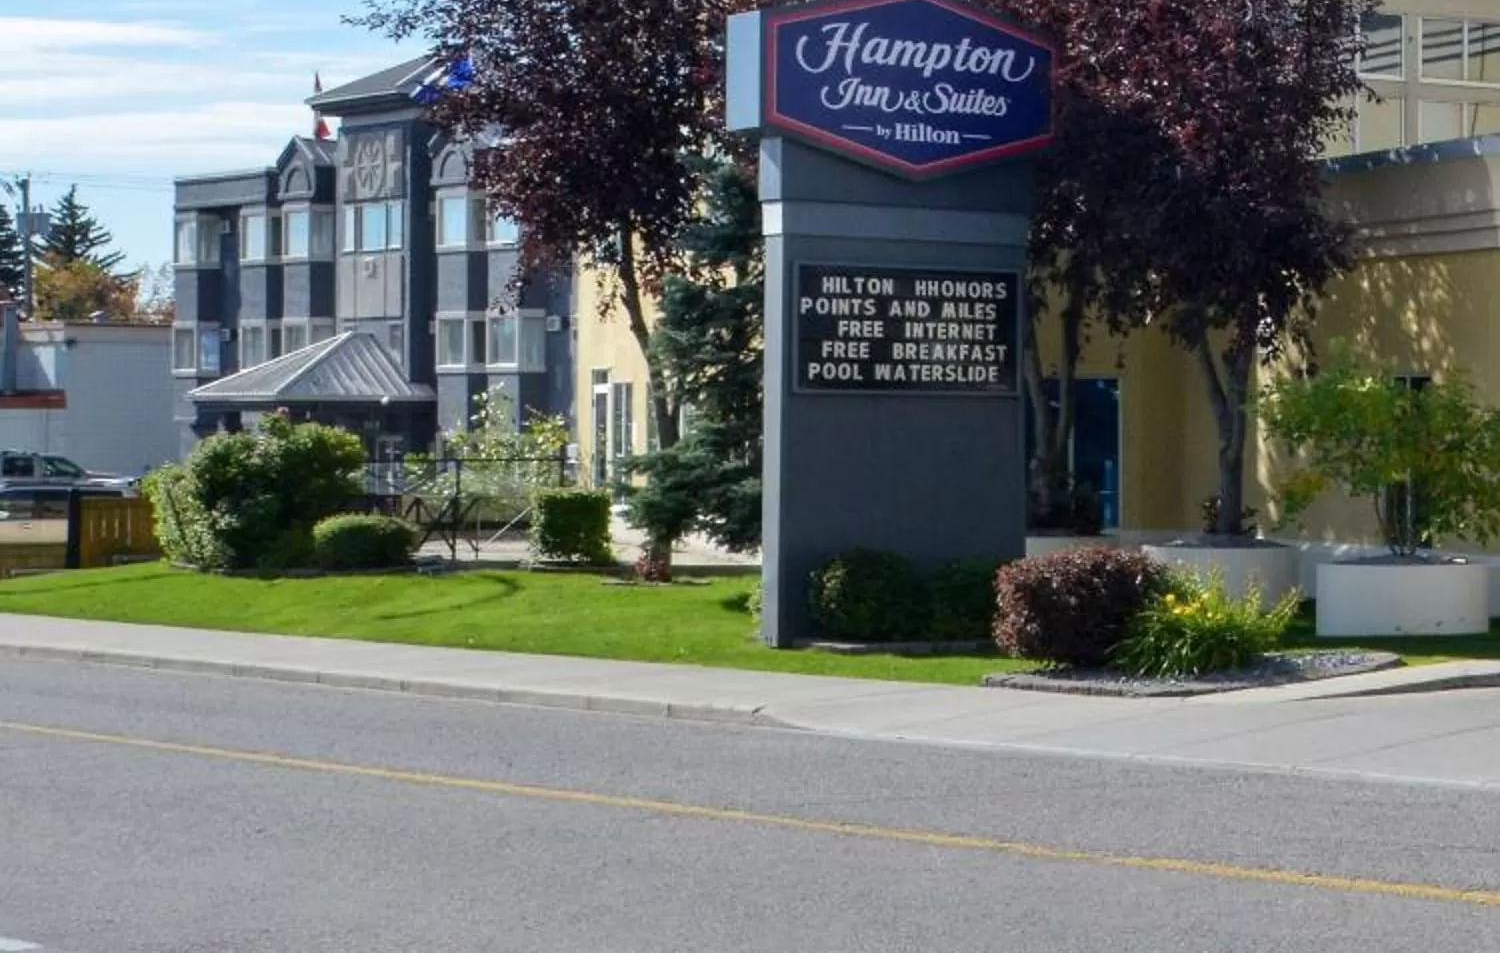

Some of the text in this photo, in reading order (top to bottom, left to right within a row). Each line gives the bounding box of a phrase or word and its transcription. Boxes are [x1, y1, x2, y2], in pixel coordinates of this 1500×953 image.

[796, 22, 1035, 82] Hampton
[820, 78, 1007, 116] Inn & Suites
[876, 122, 961, 144] by Hilton
[822, 276, 1007, 298] HILTON HHONORS
[800, 297, 997, 320] POINTS AND MILES
[838, 320, 997, 340] FREE INTERNET
[821, 341, 1007, 361] FREE BREAKFAST
[808, 362, 999, 382] POOL WATERSLIDE
